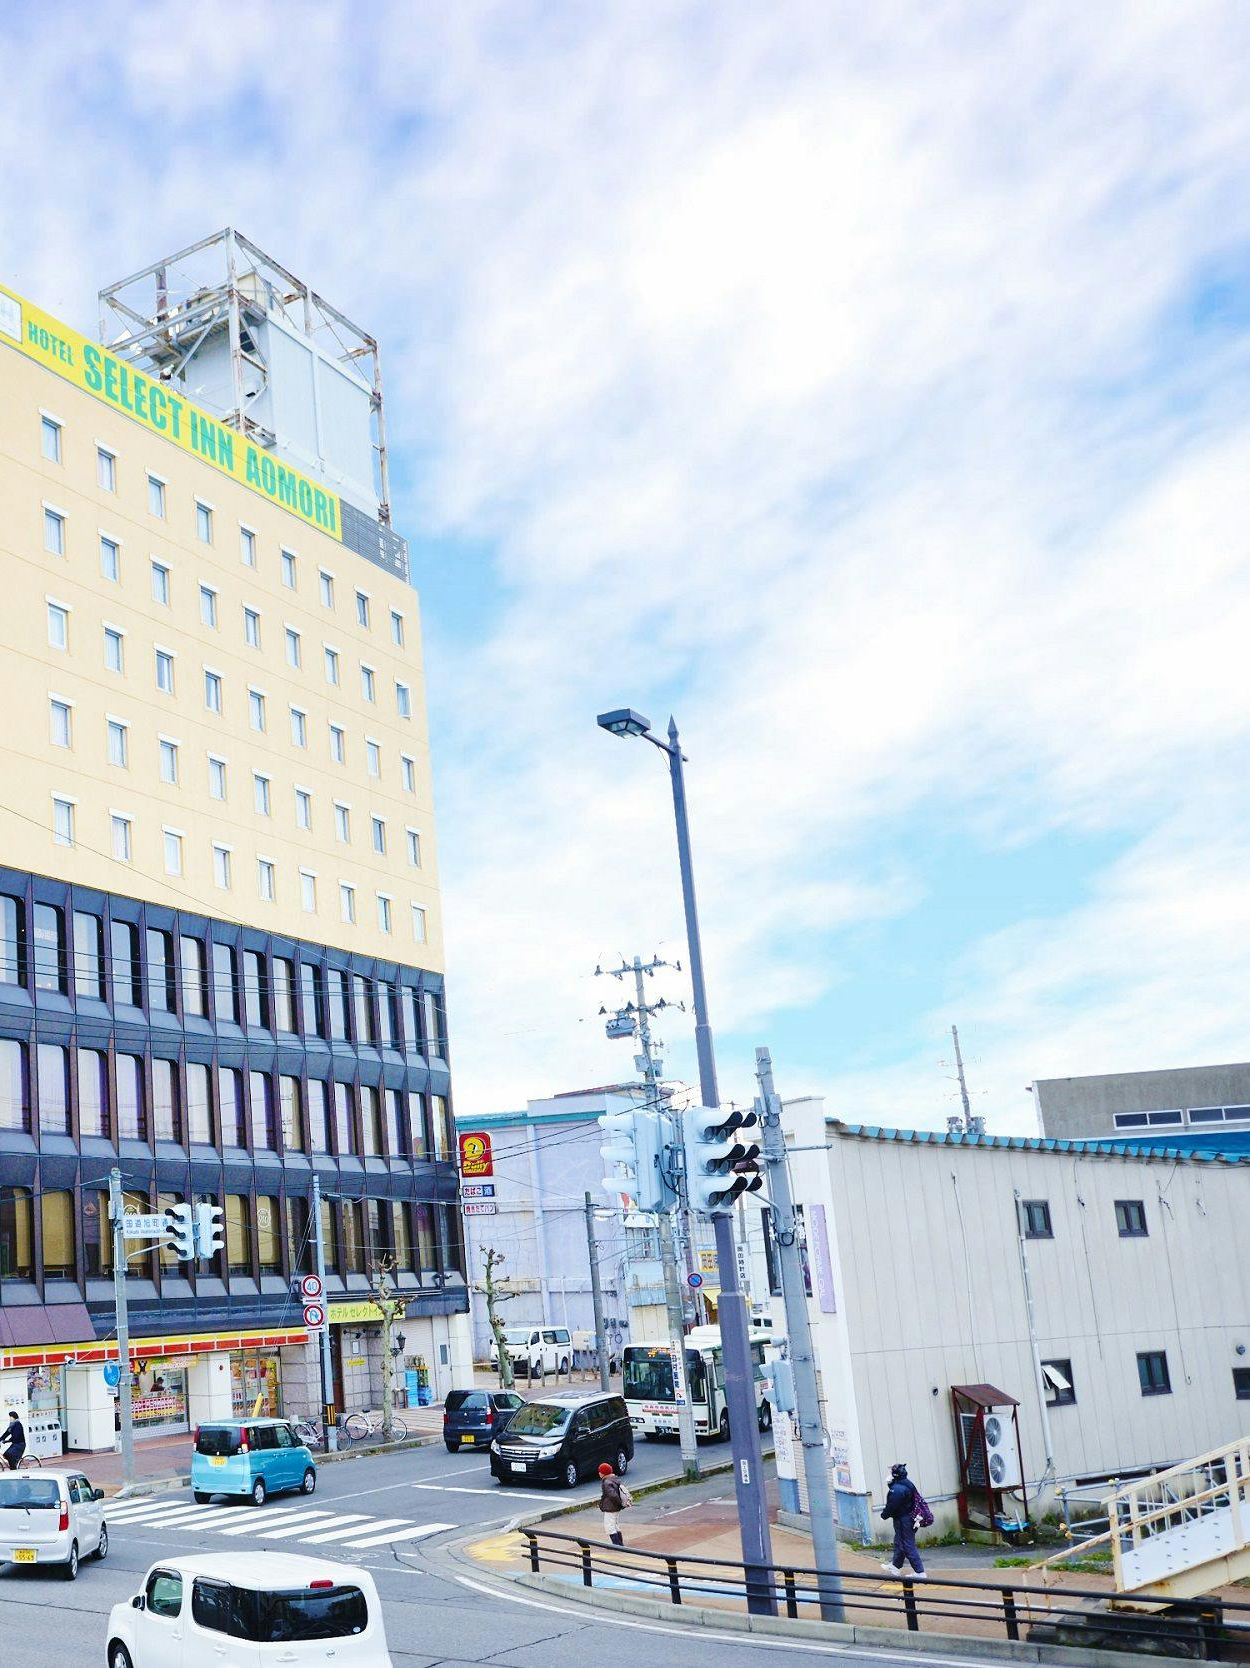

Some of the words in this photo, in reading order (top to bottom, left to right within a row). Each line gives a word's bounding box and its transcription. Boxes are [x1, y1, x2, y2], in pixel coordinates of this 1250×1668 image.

[28, 320, 75, 367] HOTEL
[83, 344, 182, 439] SELECT
[191, 410, 234, 472] INN
[246, 446, 336, 533] AOMORI
[464, 1187, 482, 1196] たばこ
[307, 1281, 317, 1291] 40
[330, 1306, 348, 1320] ホテル
